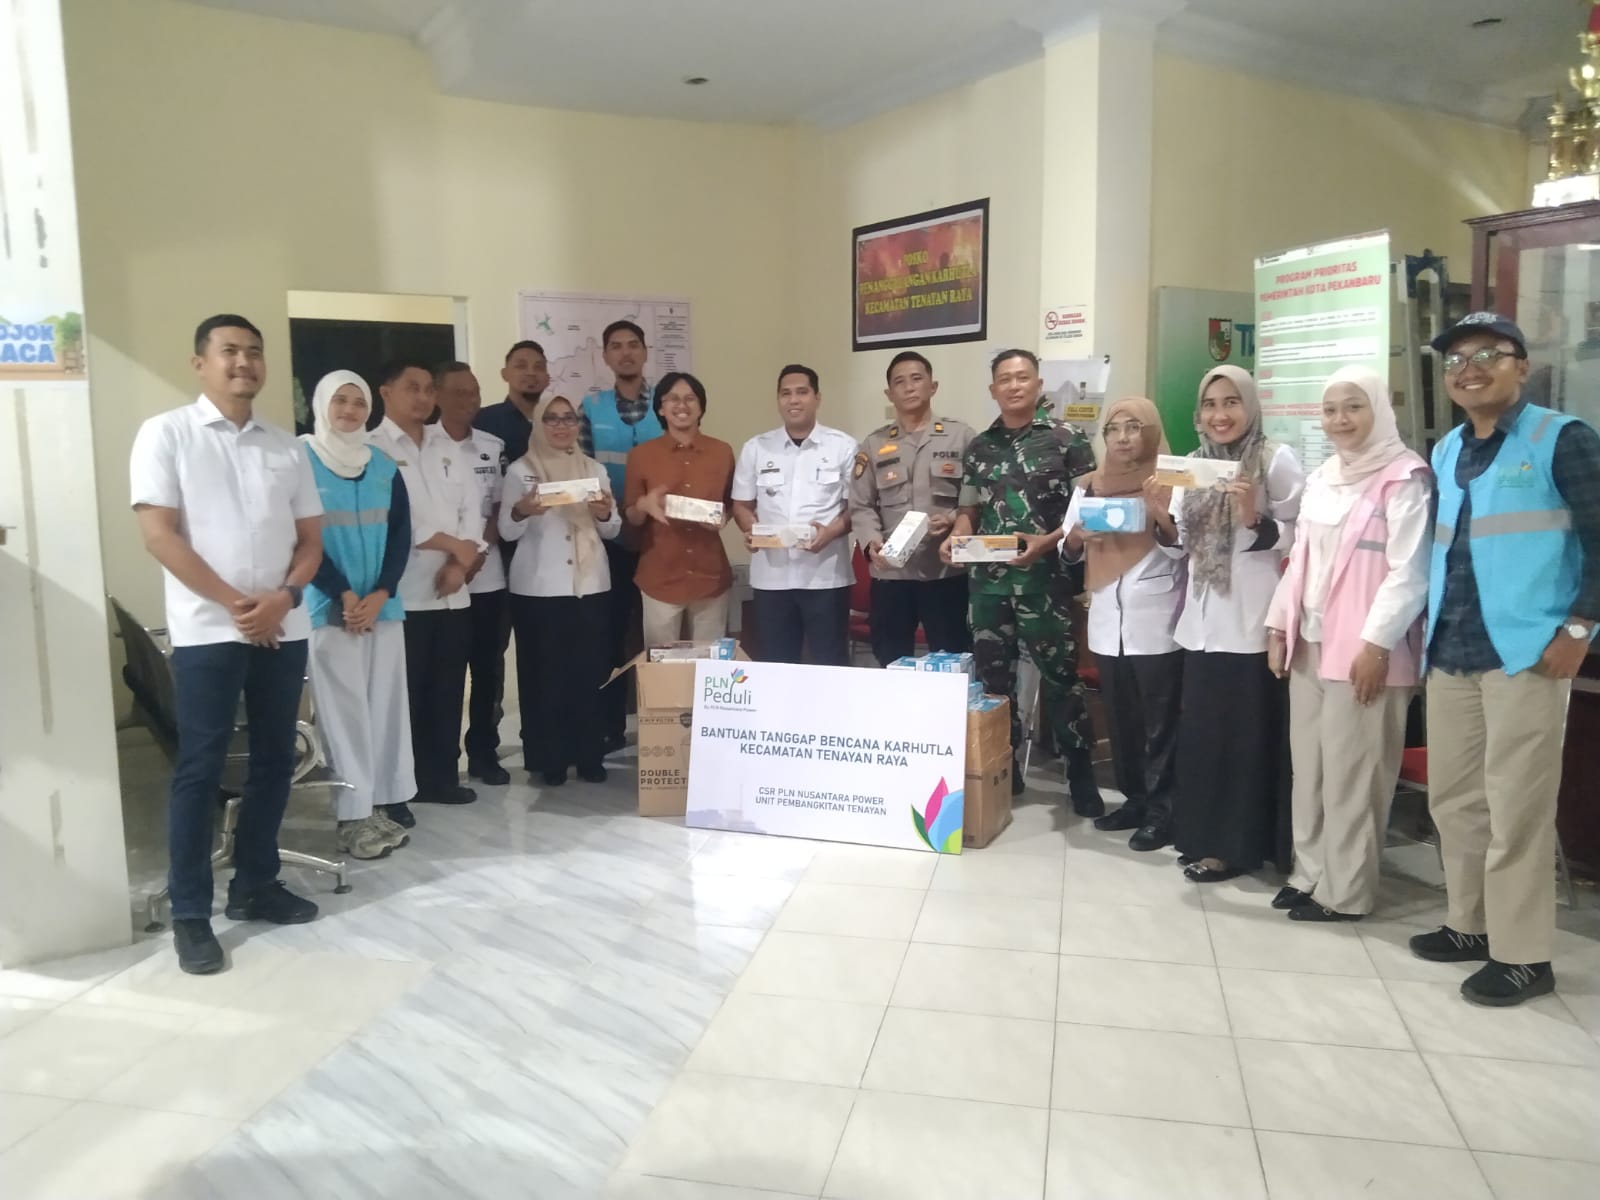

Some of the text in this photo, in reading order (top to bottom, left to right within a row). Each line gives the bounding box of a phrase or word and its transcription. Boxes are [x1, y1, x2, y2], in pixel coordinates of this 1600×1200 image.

[1275, 261, 1358, 285] PROGRAM PRIORITAS
[910, 290, 948, 309] TENAYAN
[950, 287, 974, 304] RAYA
[1260, 275, 1382, 302] PEMERINTAH KOTA PEKANBARU
[932, 451, 960, 459] POLRI
[704, 676, 729, 689] PLN
[703, 687, 752, 705] Peduli
[700, 726, 954, 757] BANTUAN TANGGAP BENCANA KARHUTLA
[740, 743, 909, 767] KECAMATAN TENAYAN RAYA
[640, 769, 681, 777] DOUBLE
[755, 796, 887, 816] UNIT PEMBANGKITAN TENAYAN
[758, 786, 884, 806] CSR PLN NUSANTARA POWER
